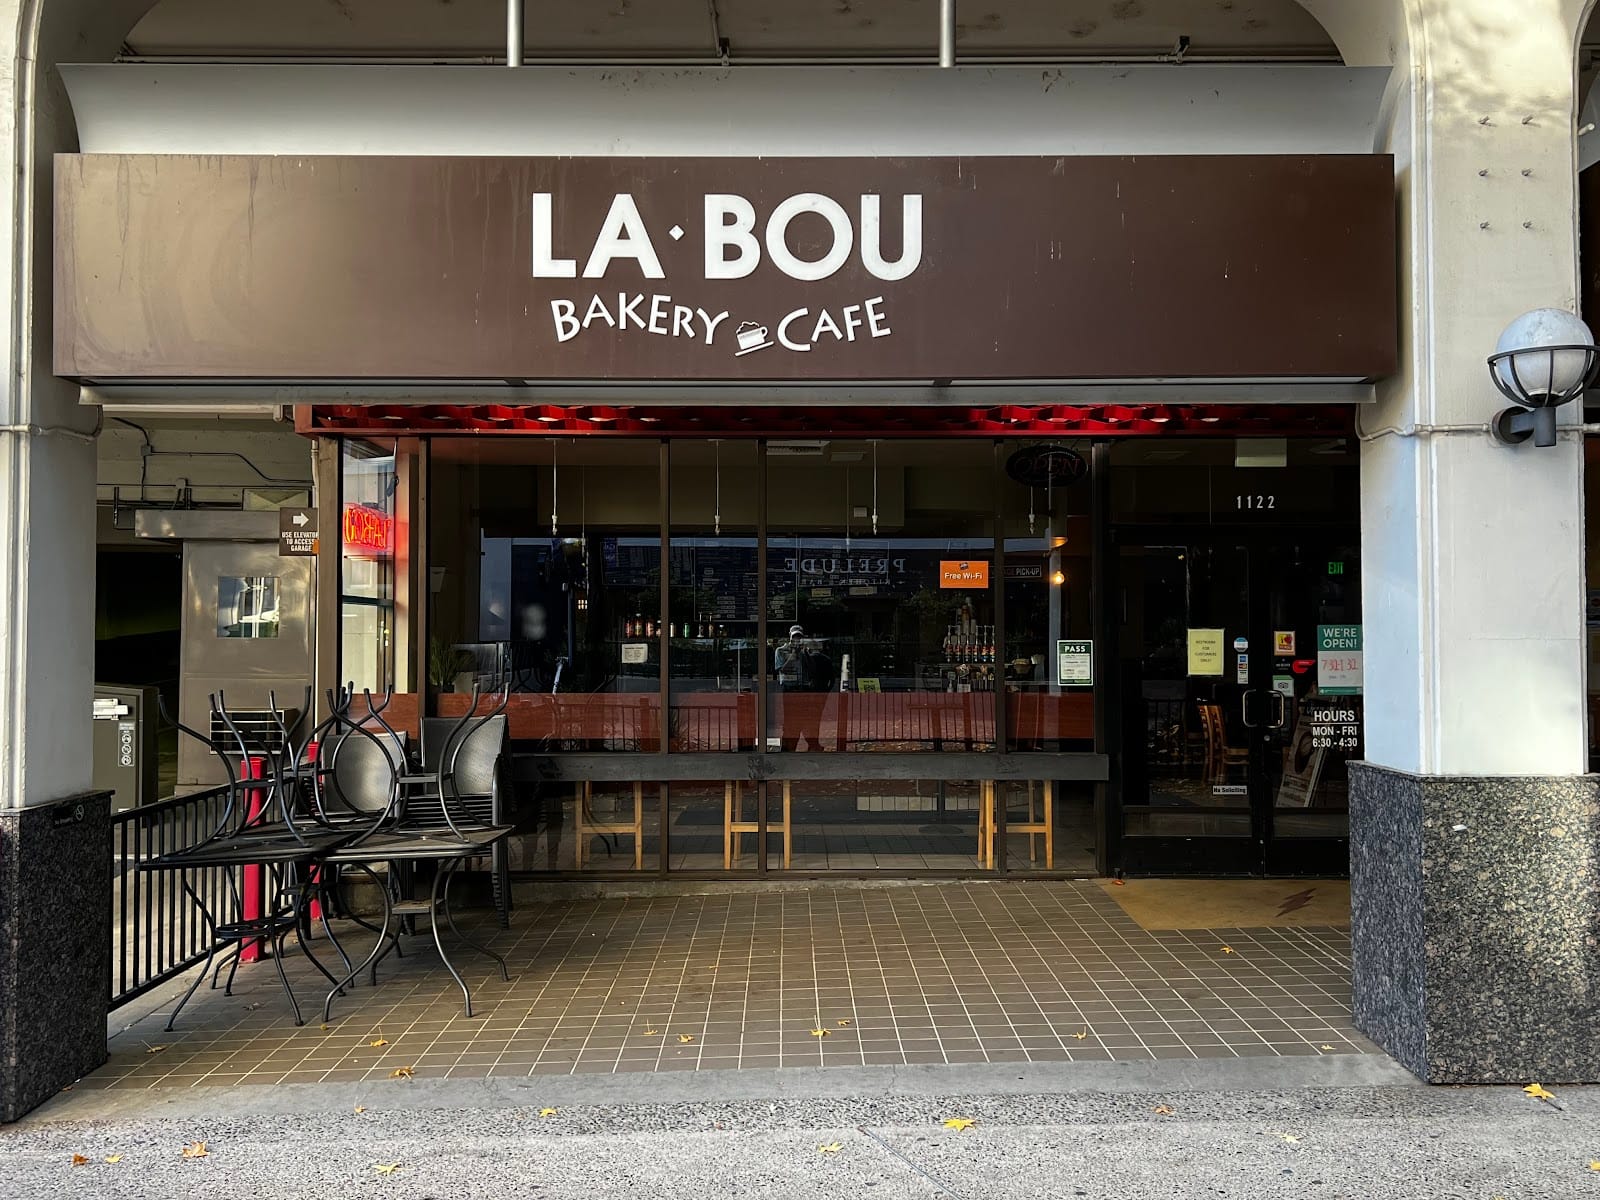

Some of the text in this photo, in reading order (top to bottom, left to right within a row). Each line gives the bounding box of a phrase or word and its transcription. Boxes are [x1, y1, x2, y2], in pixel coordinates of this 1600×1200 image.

[532, 192, 923, 281] LA BOU
[550, 292, 729, 345] BAKERY
[776, 295, 892, 352] CAFE
[1013, 456, 1082, 477] OPEN
[1236, 495, 1275, 509] 1122
[281, 531, 293, 539] USE
[1015, 567, 1040, 576] PICK-UP
[1328, 562, 1344, 574] EXIT
[944, 572, 983, 580] Free Wi-Fi
[1323, 628, 1357, 638] WE'RE
[1064, 645, 1086, 653] PASS
[1323, 639, 1357, 648] OPEN!
[1313, 710, 1355, 722] HOURS
[1312, 726, 1335, 736] MON
[1341, 726, 1358, 736] FRI
[1312, 738, 1332, 748] 6:30
[1338, 737, 1358, 747] 4:30
